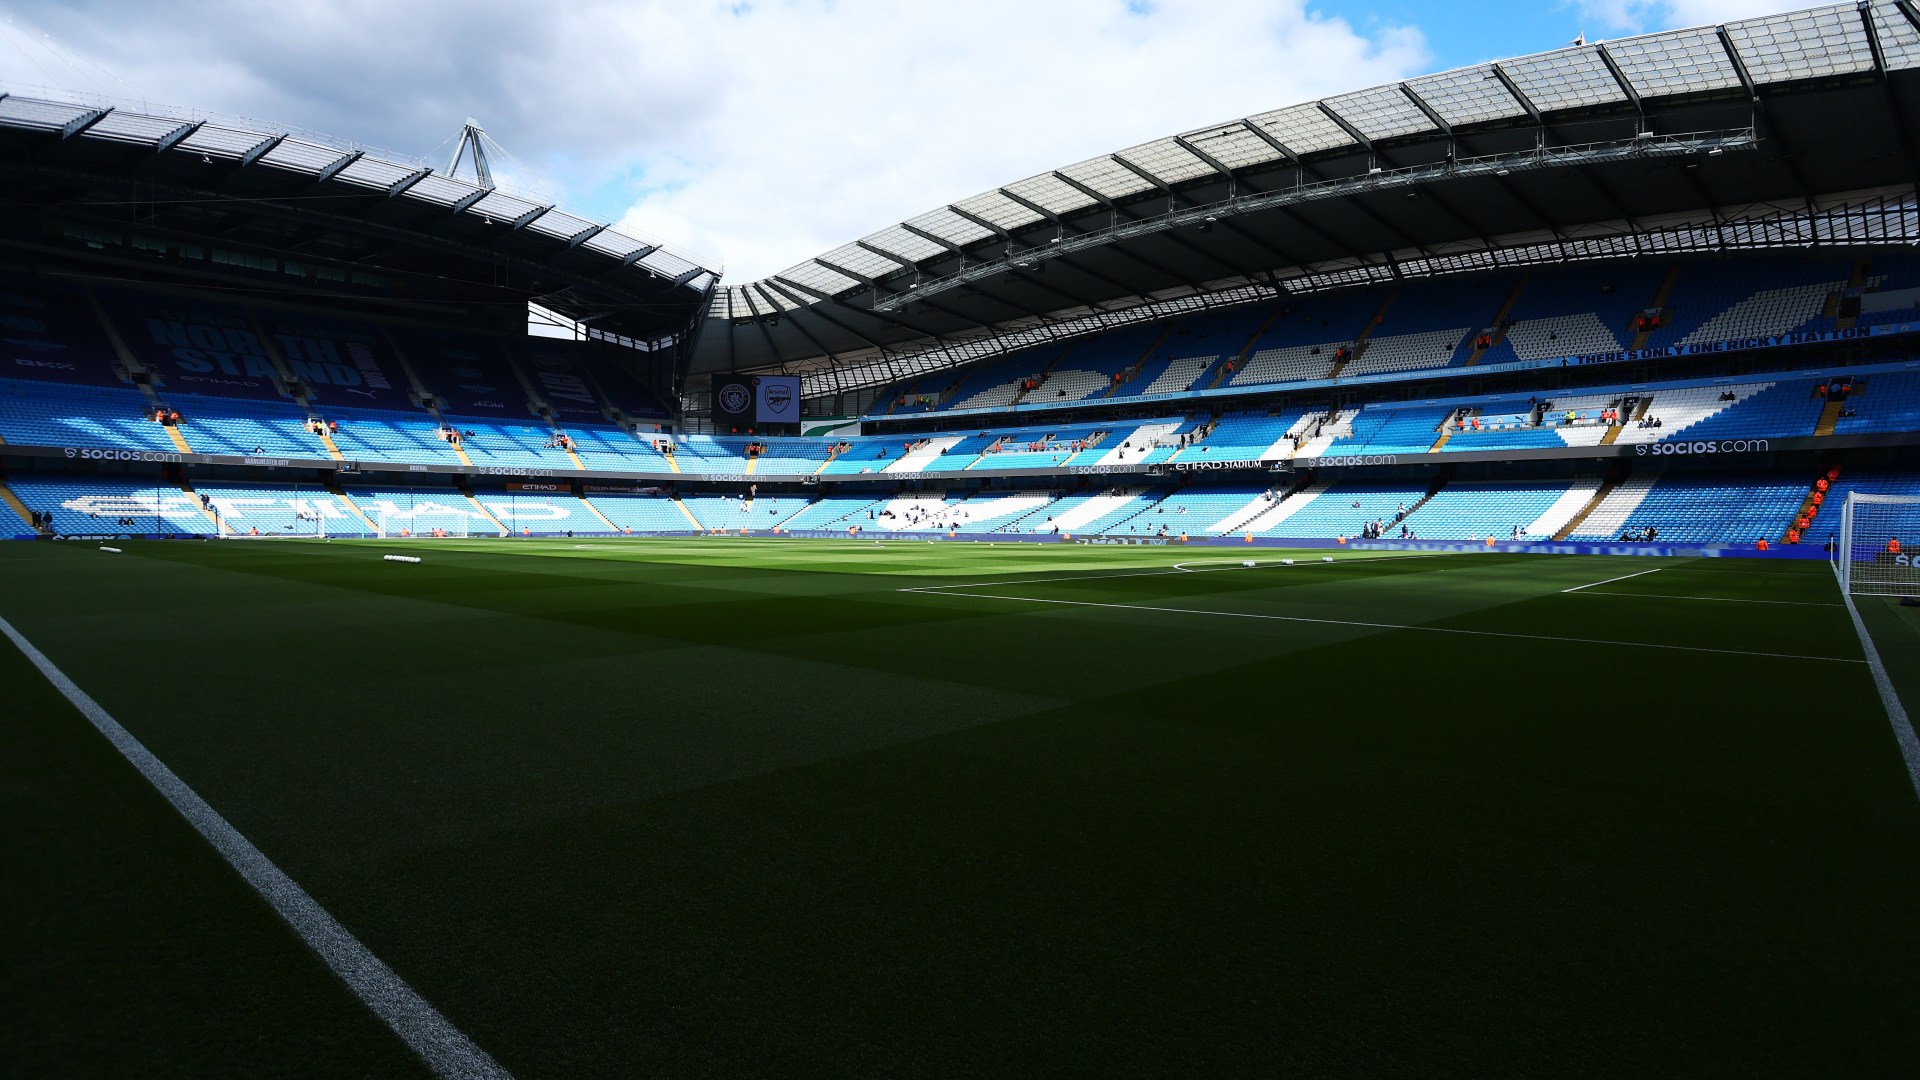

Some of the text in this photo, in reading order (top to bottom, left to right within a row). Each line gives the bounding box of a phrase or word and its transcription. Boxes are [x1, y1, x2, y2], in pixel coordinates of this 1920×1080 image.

[146, 317, 343, 364] NORTH
[1577, 327, 1871, 364] THERE'S ONLY ONE RICKY HATTON
[170, 346, 362, 386] STAND
[180, 376, 260, 388] ETIHAD
[1652, 439, 1768, 455] SOCIOS.com
[81, 449, 182, 462] SOCIOS.com
[244, 458, 278, 466] MANCHESTER
[1319, 454, 1396, 467] SOCIOS.com
[1175, 461, 1262, 470] ETIHAD STADIUM
